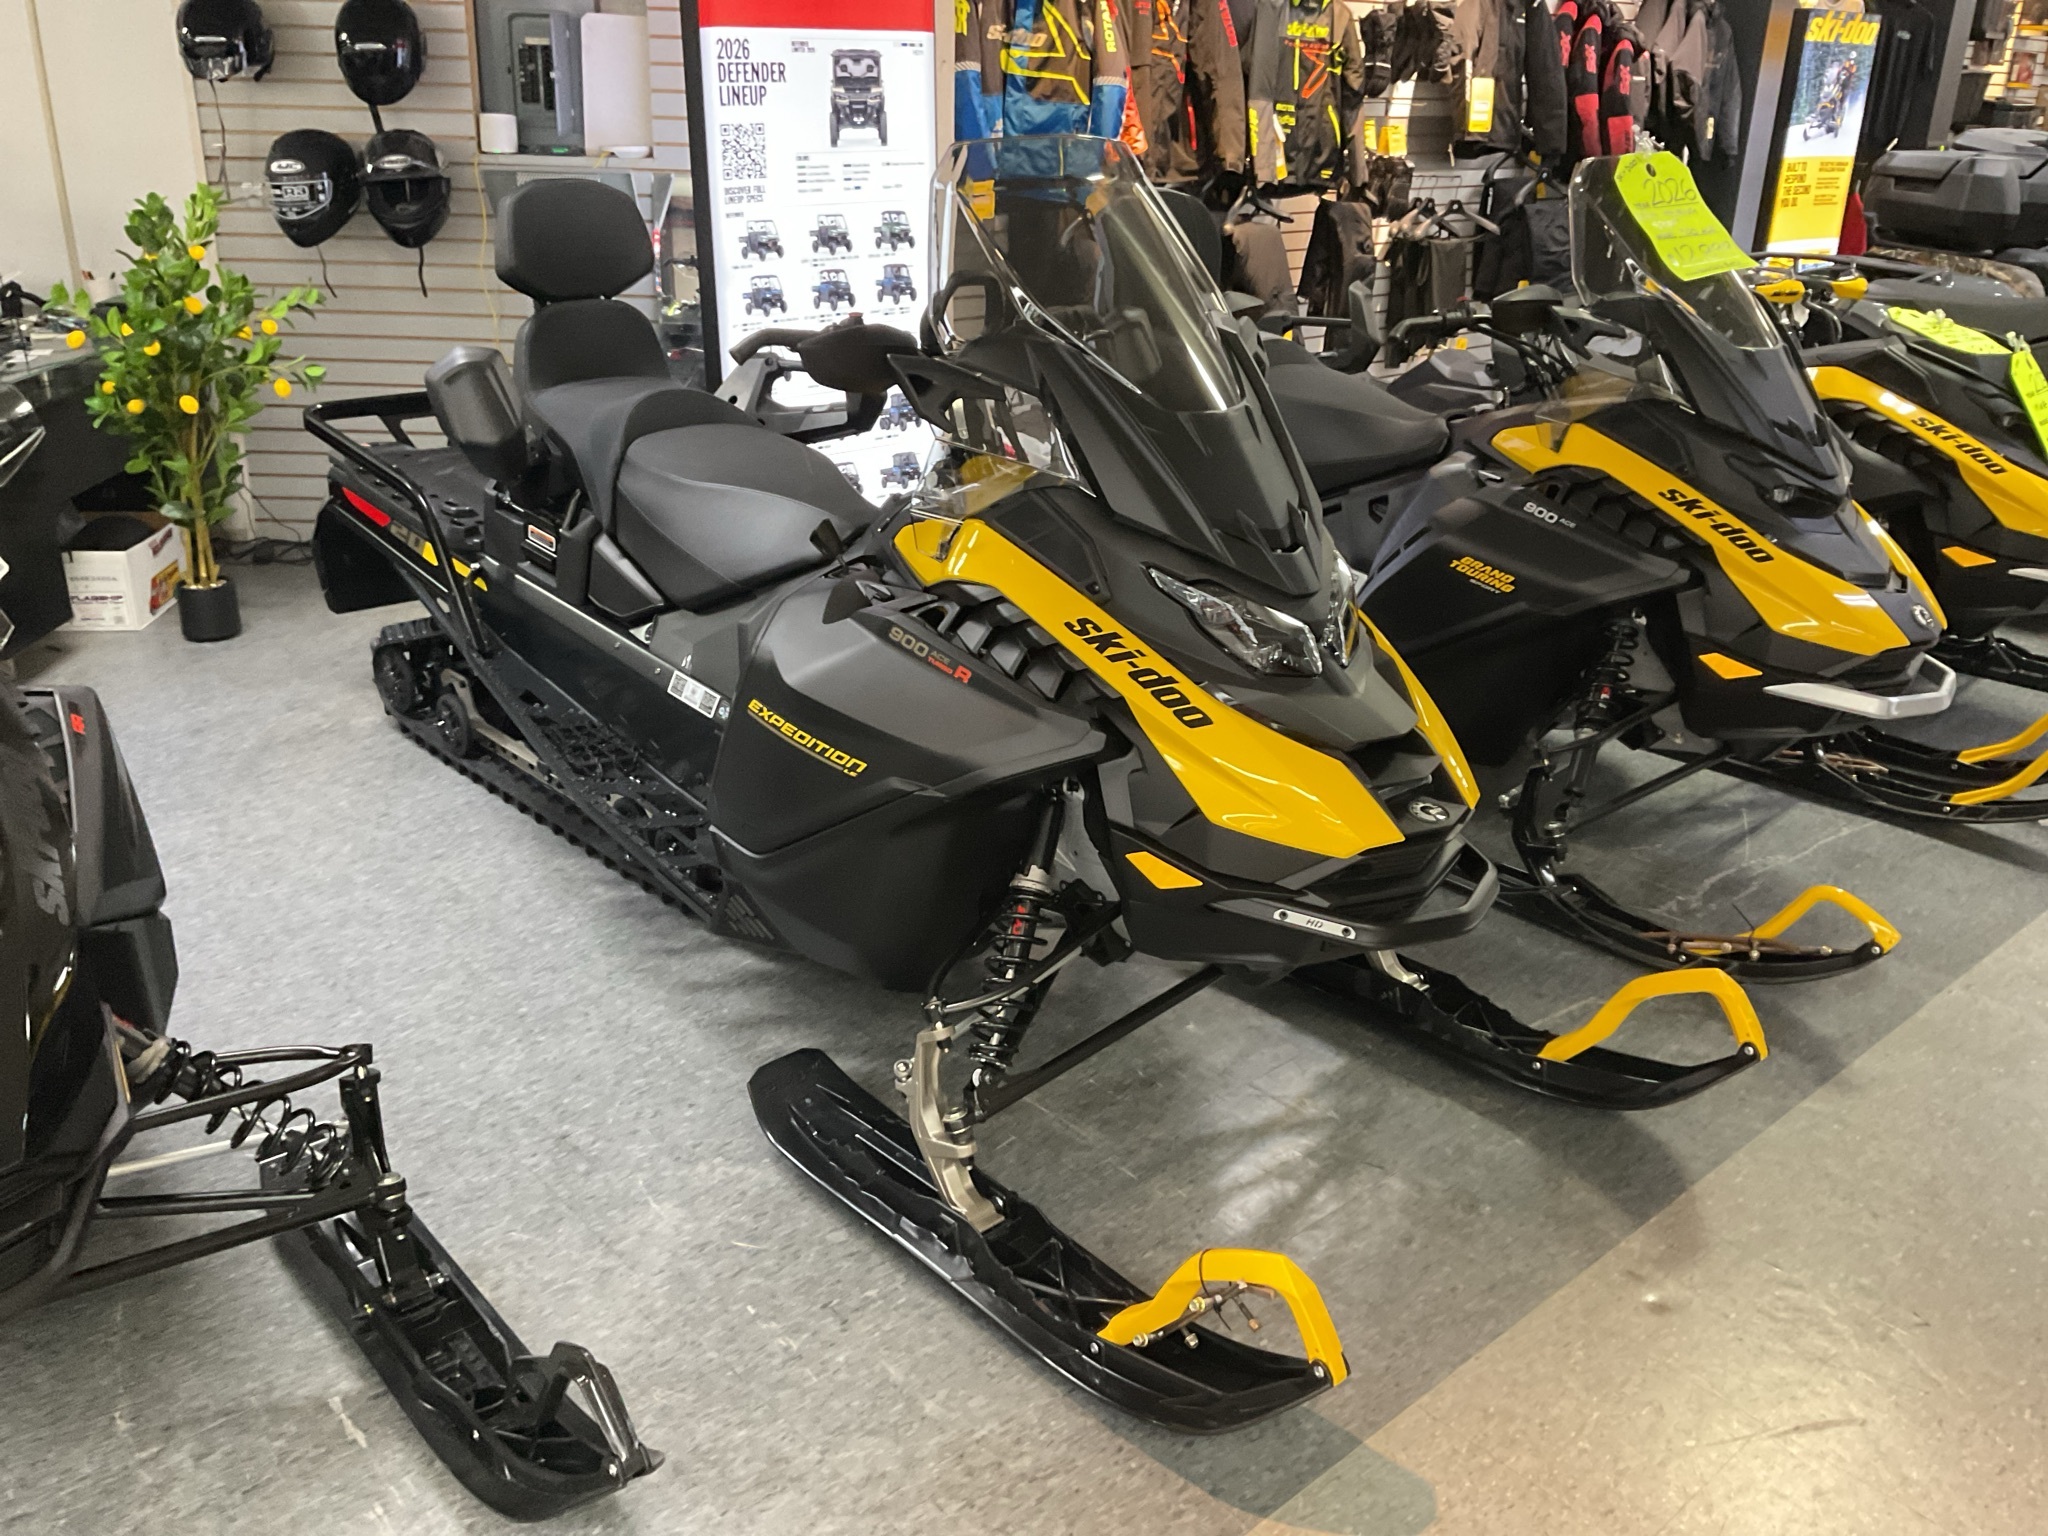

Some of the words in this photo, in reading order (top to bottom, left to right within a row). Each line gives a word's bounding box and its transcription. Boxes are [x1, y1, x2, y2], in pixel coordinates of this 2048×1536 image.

[1805, 10, 1880, 45] ski-doo
[716, 38, 750, 60] 2026
[717, 62, 787, 83] DEFENDER
[719, 85, 767, 107] LINEUP
[1643, 177, 1698, 207] 2026
[1912, 417, 2008, 474] ski-doo
[1523, 501, 1558, 524] 900
[1658, 489, 1775, 563] ski-doo
[1449, 559, 1516, 593] TOURING
[1461, 556, 1516, 583] GRAND
[888, 626, 930, 658] 900
[953, 665, 972, 684] R
[1064, 617, 1214, 729] ski-doo
[748, 699, 868, 773] EXPEDITION
[1305, 918, 1324, 929] HD
